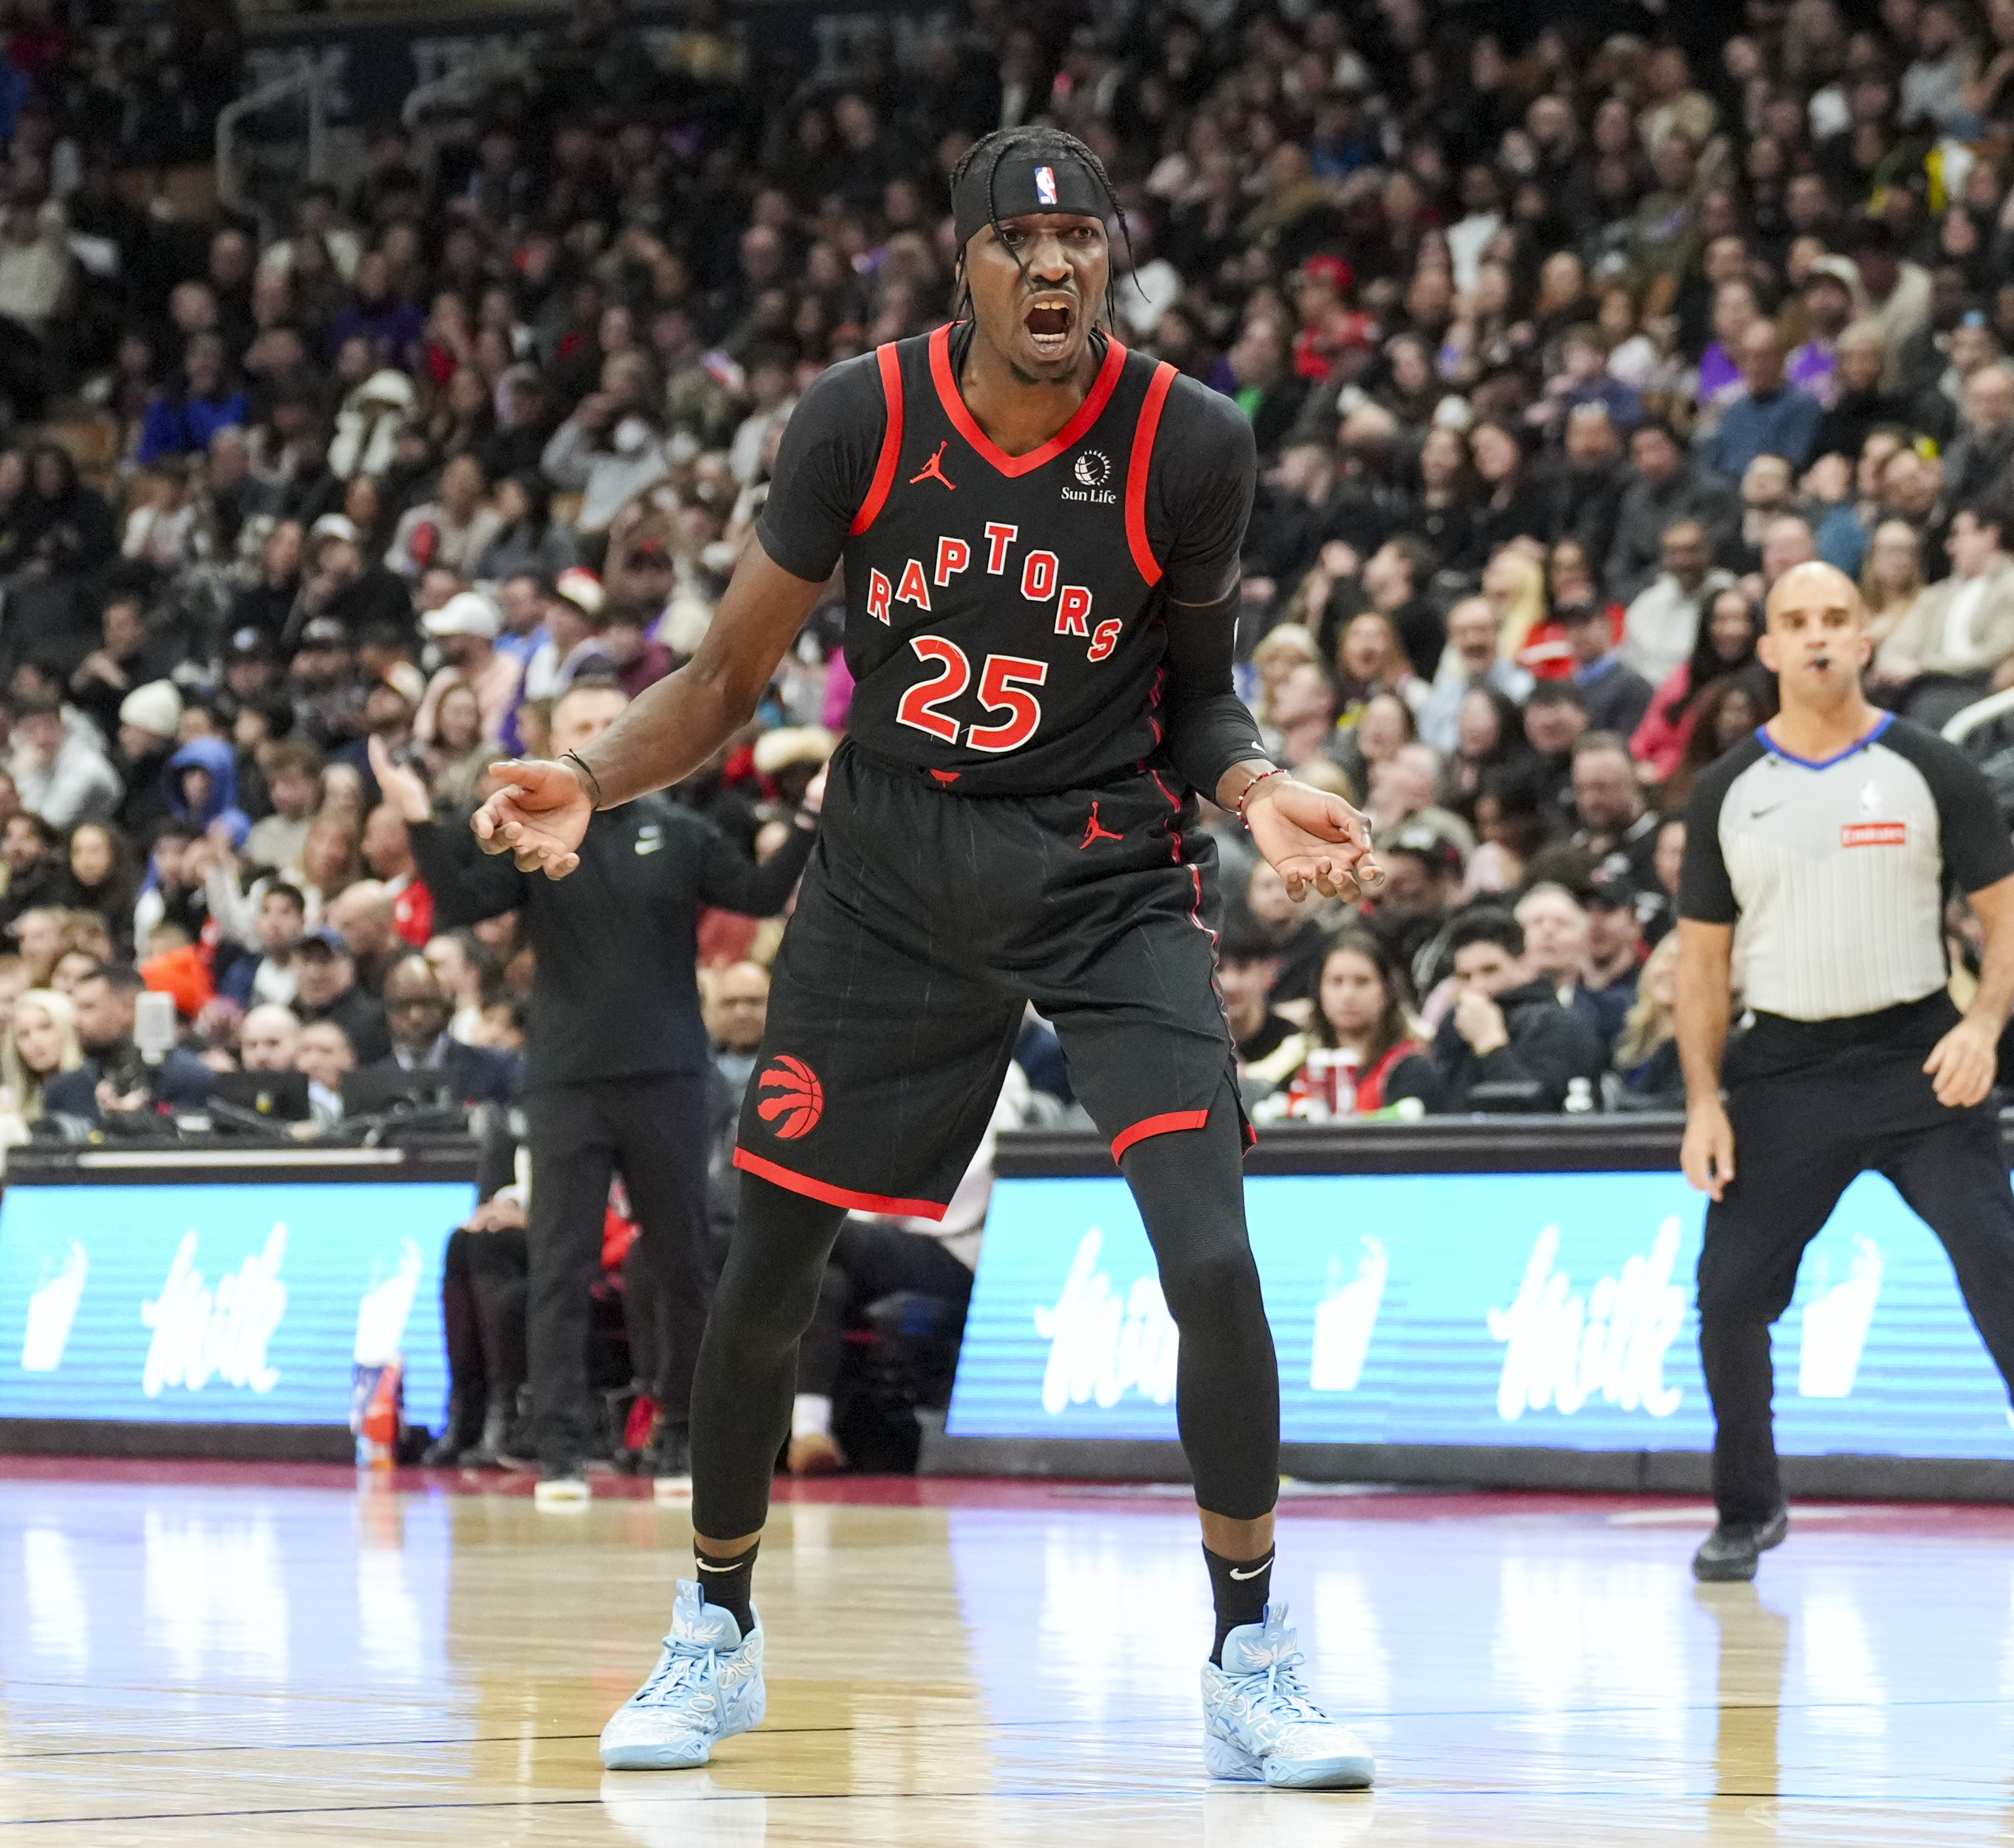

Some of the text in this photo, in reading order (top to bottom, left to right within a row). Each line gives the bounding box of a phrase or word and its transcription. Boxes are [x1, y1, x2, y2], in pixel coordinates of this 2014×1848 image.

[1061, 487, 1116, 504] Sun Life
[867, 522, 1123, 663] RAPTORS
[896, 635, 1048, 753] 25
